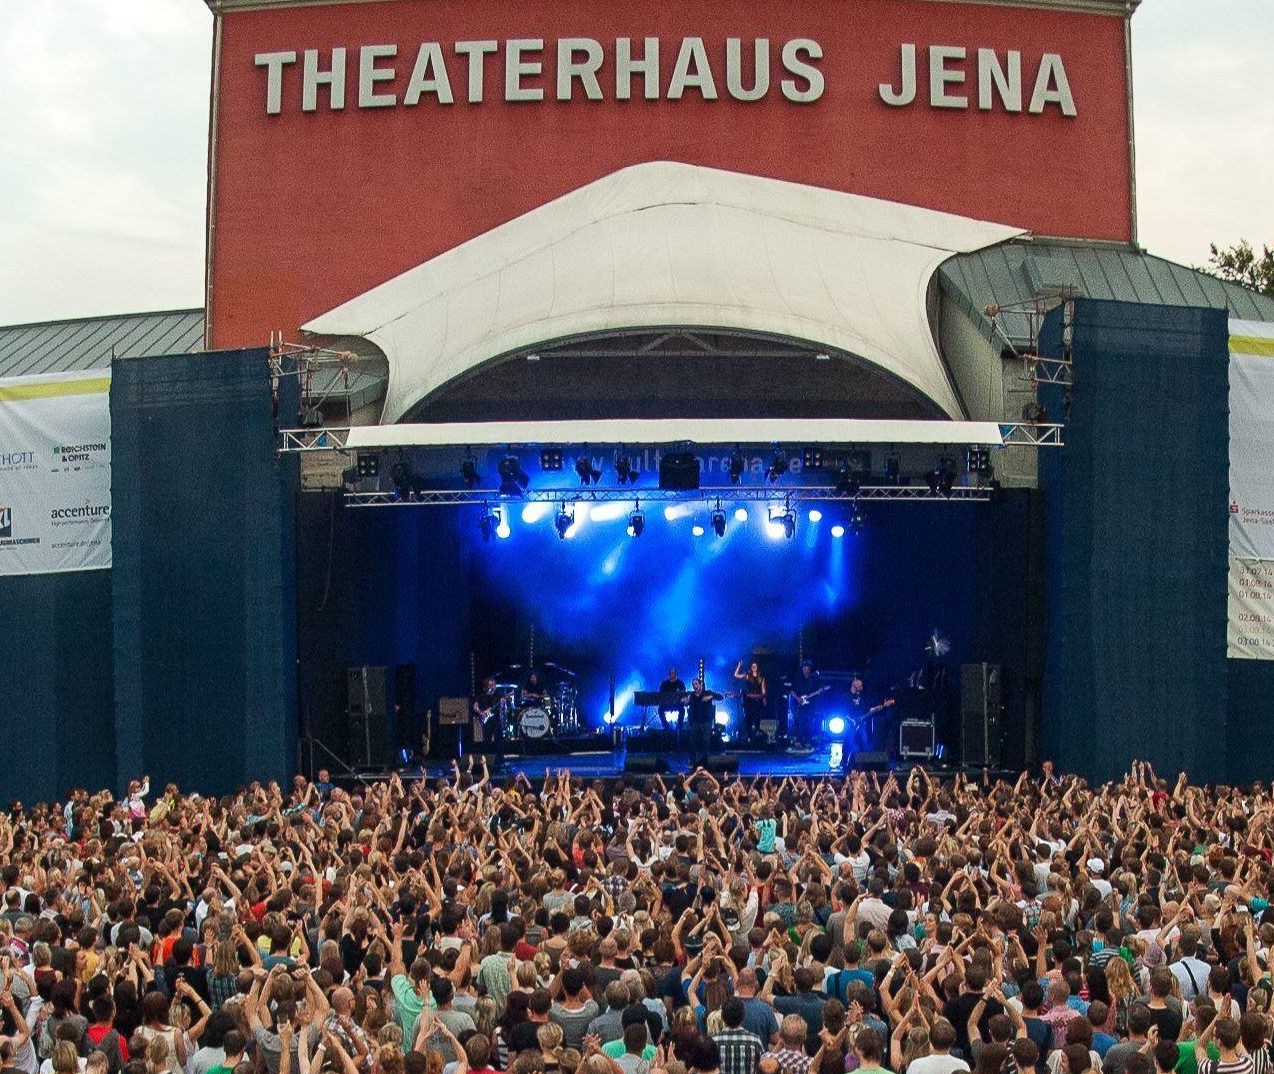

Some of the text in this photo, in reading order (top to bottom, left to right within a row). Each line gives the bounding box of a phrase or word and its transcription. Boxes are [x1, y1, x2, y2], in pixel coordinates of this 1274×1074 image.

[254, 37, 1077, 117] THEATERHAUS JENA
[68, 453, 90, 462] OPITZ
[51, 504, 110, 519] accenture
